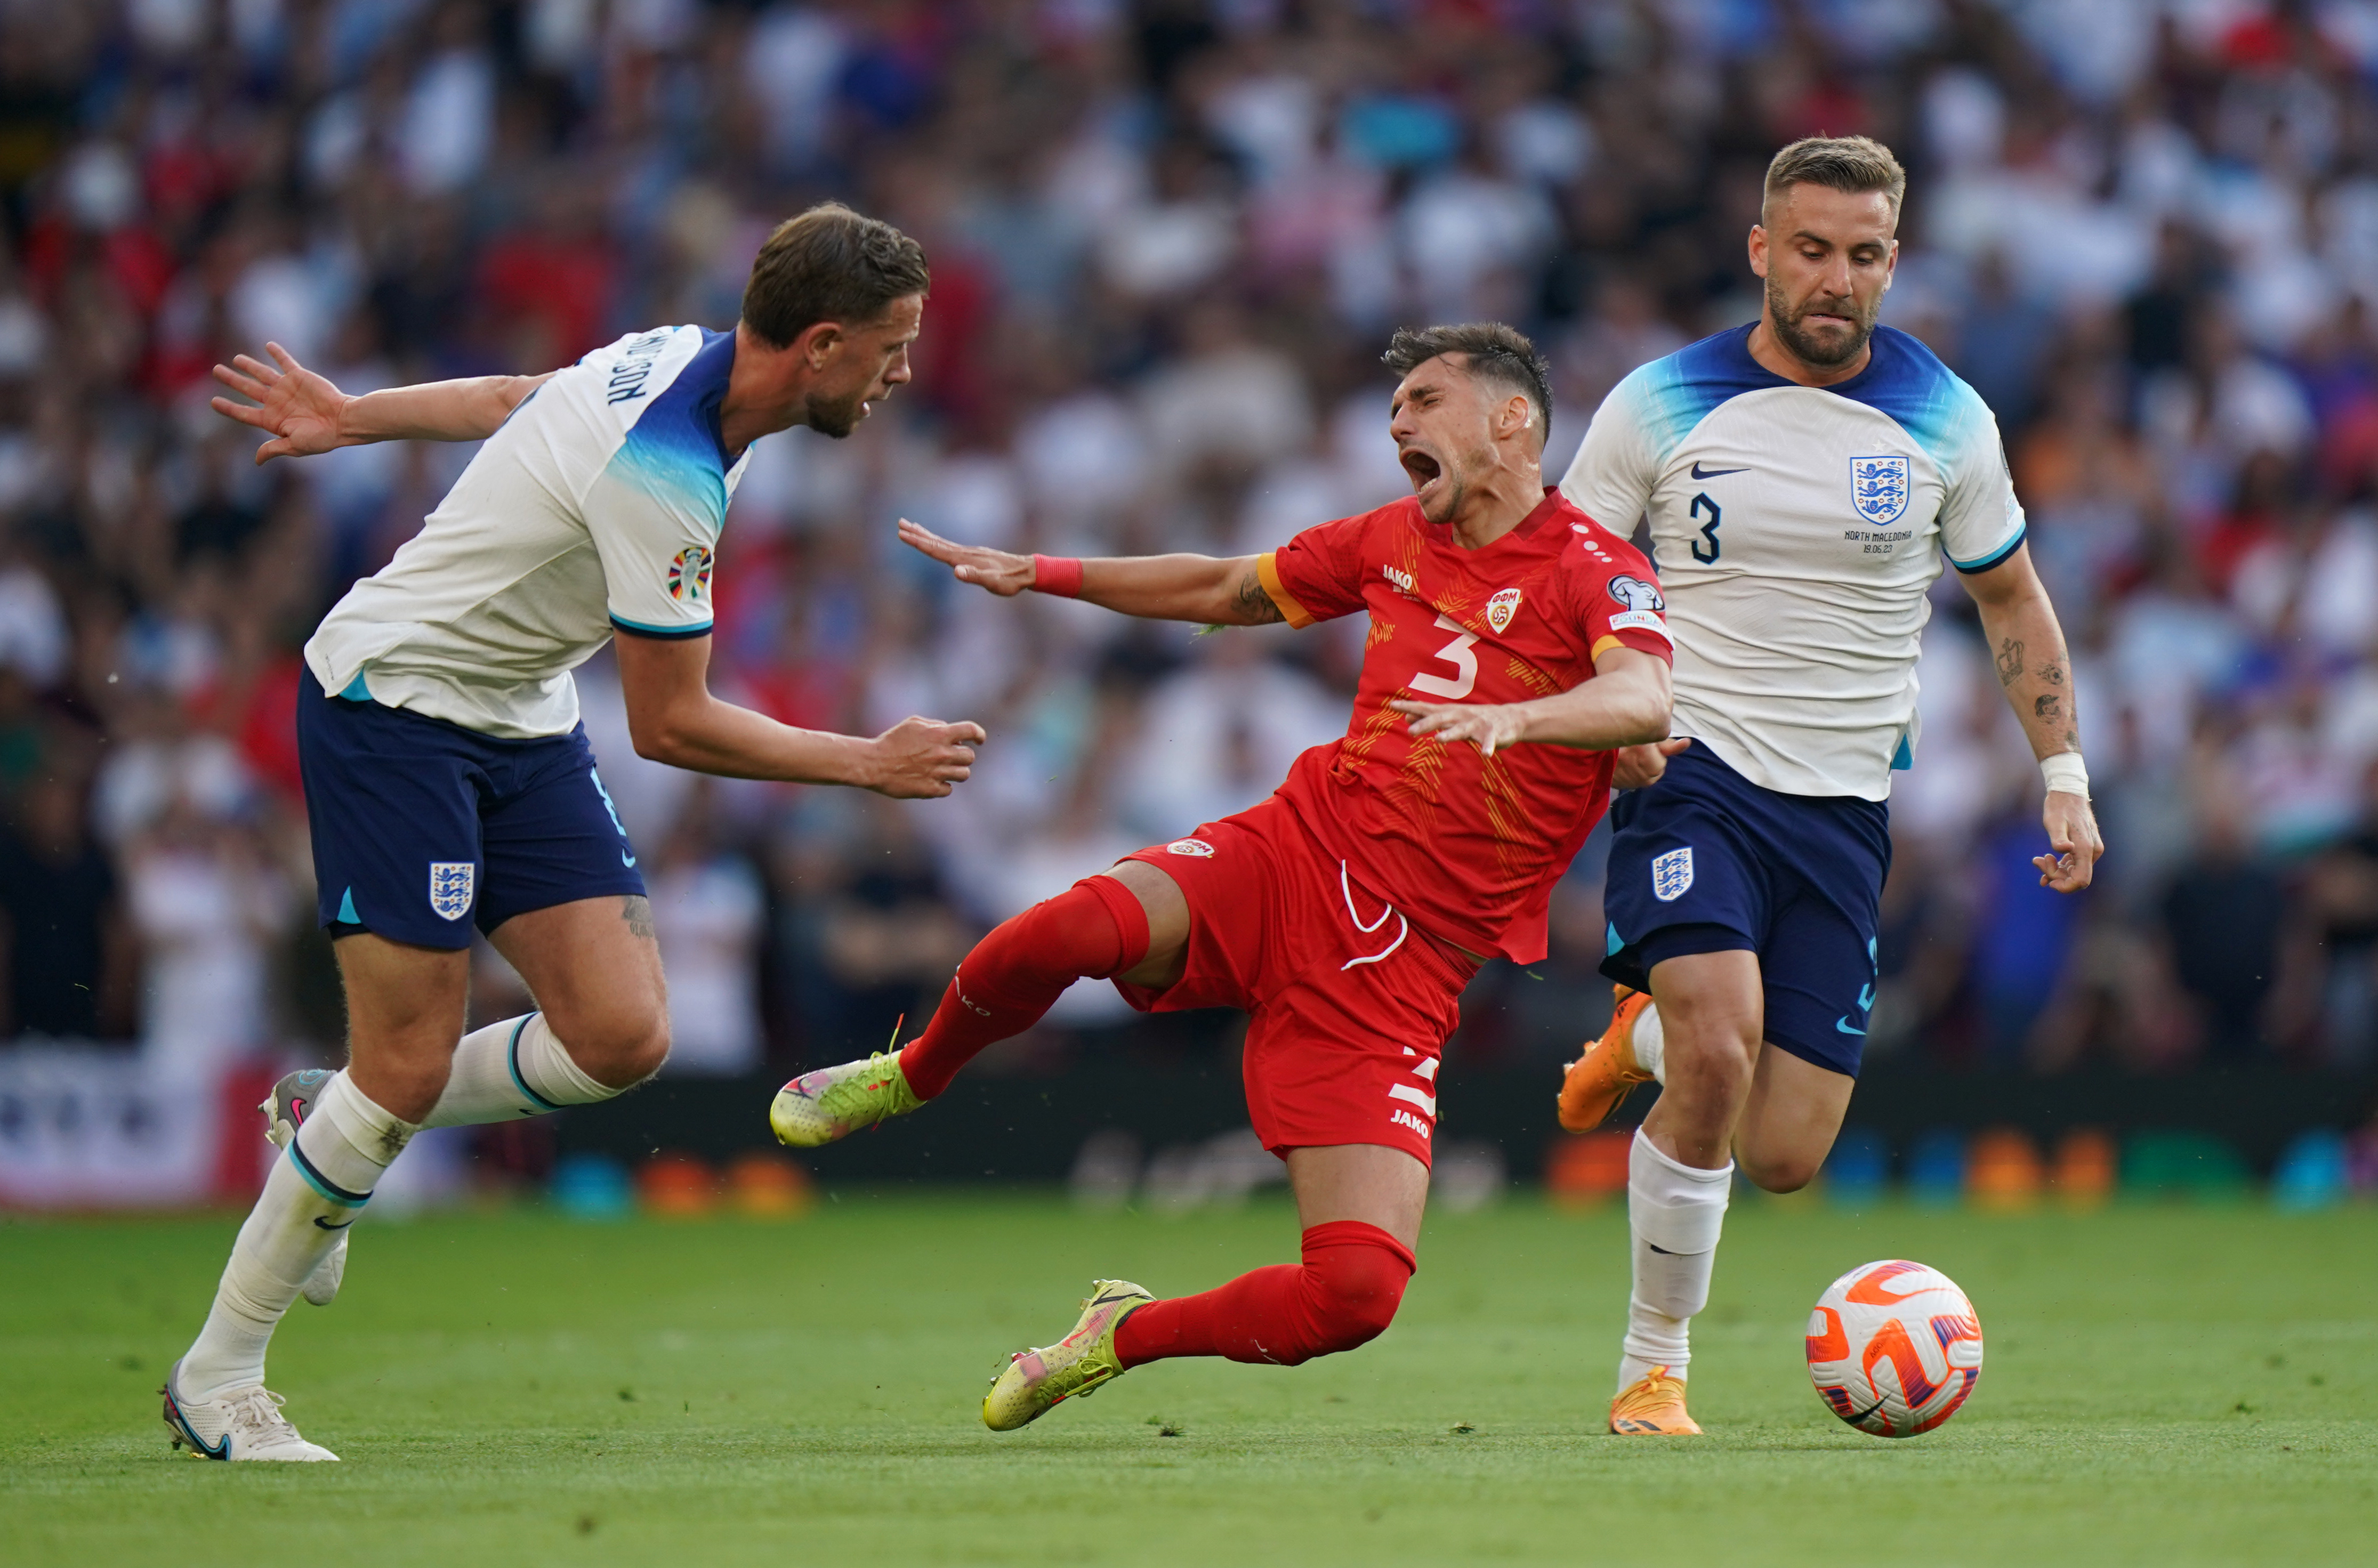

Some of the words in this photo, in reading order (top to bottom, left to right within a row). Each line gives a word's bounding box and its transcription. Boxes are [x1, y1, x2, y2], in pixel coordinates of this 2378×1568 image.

[1690, 491, 1722, 565] 3
[1844, 530, 1871, 541] NORTH
[1864, 544, 1893, 553] 19.06.23
[1383, 564, 1413, 590] JAKO
[1408, 612, 1481, 700] 3
[1390, 1109, 1429, 1139] JAKO
